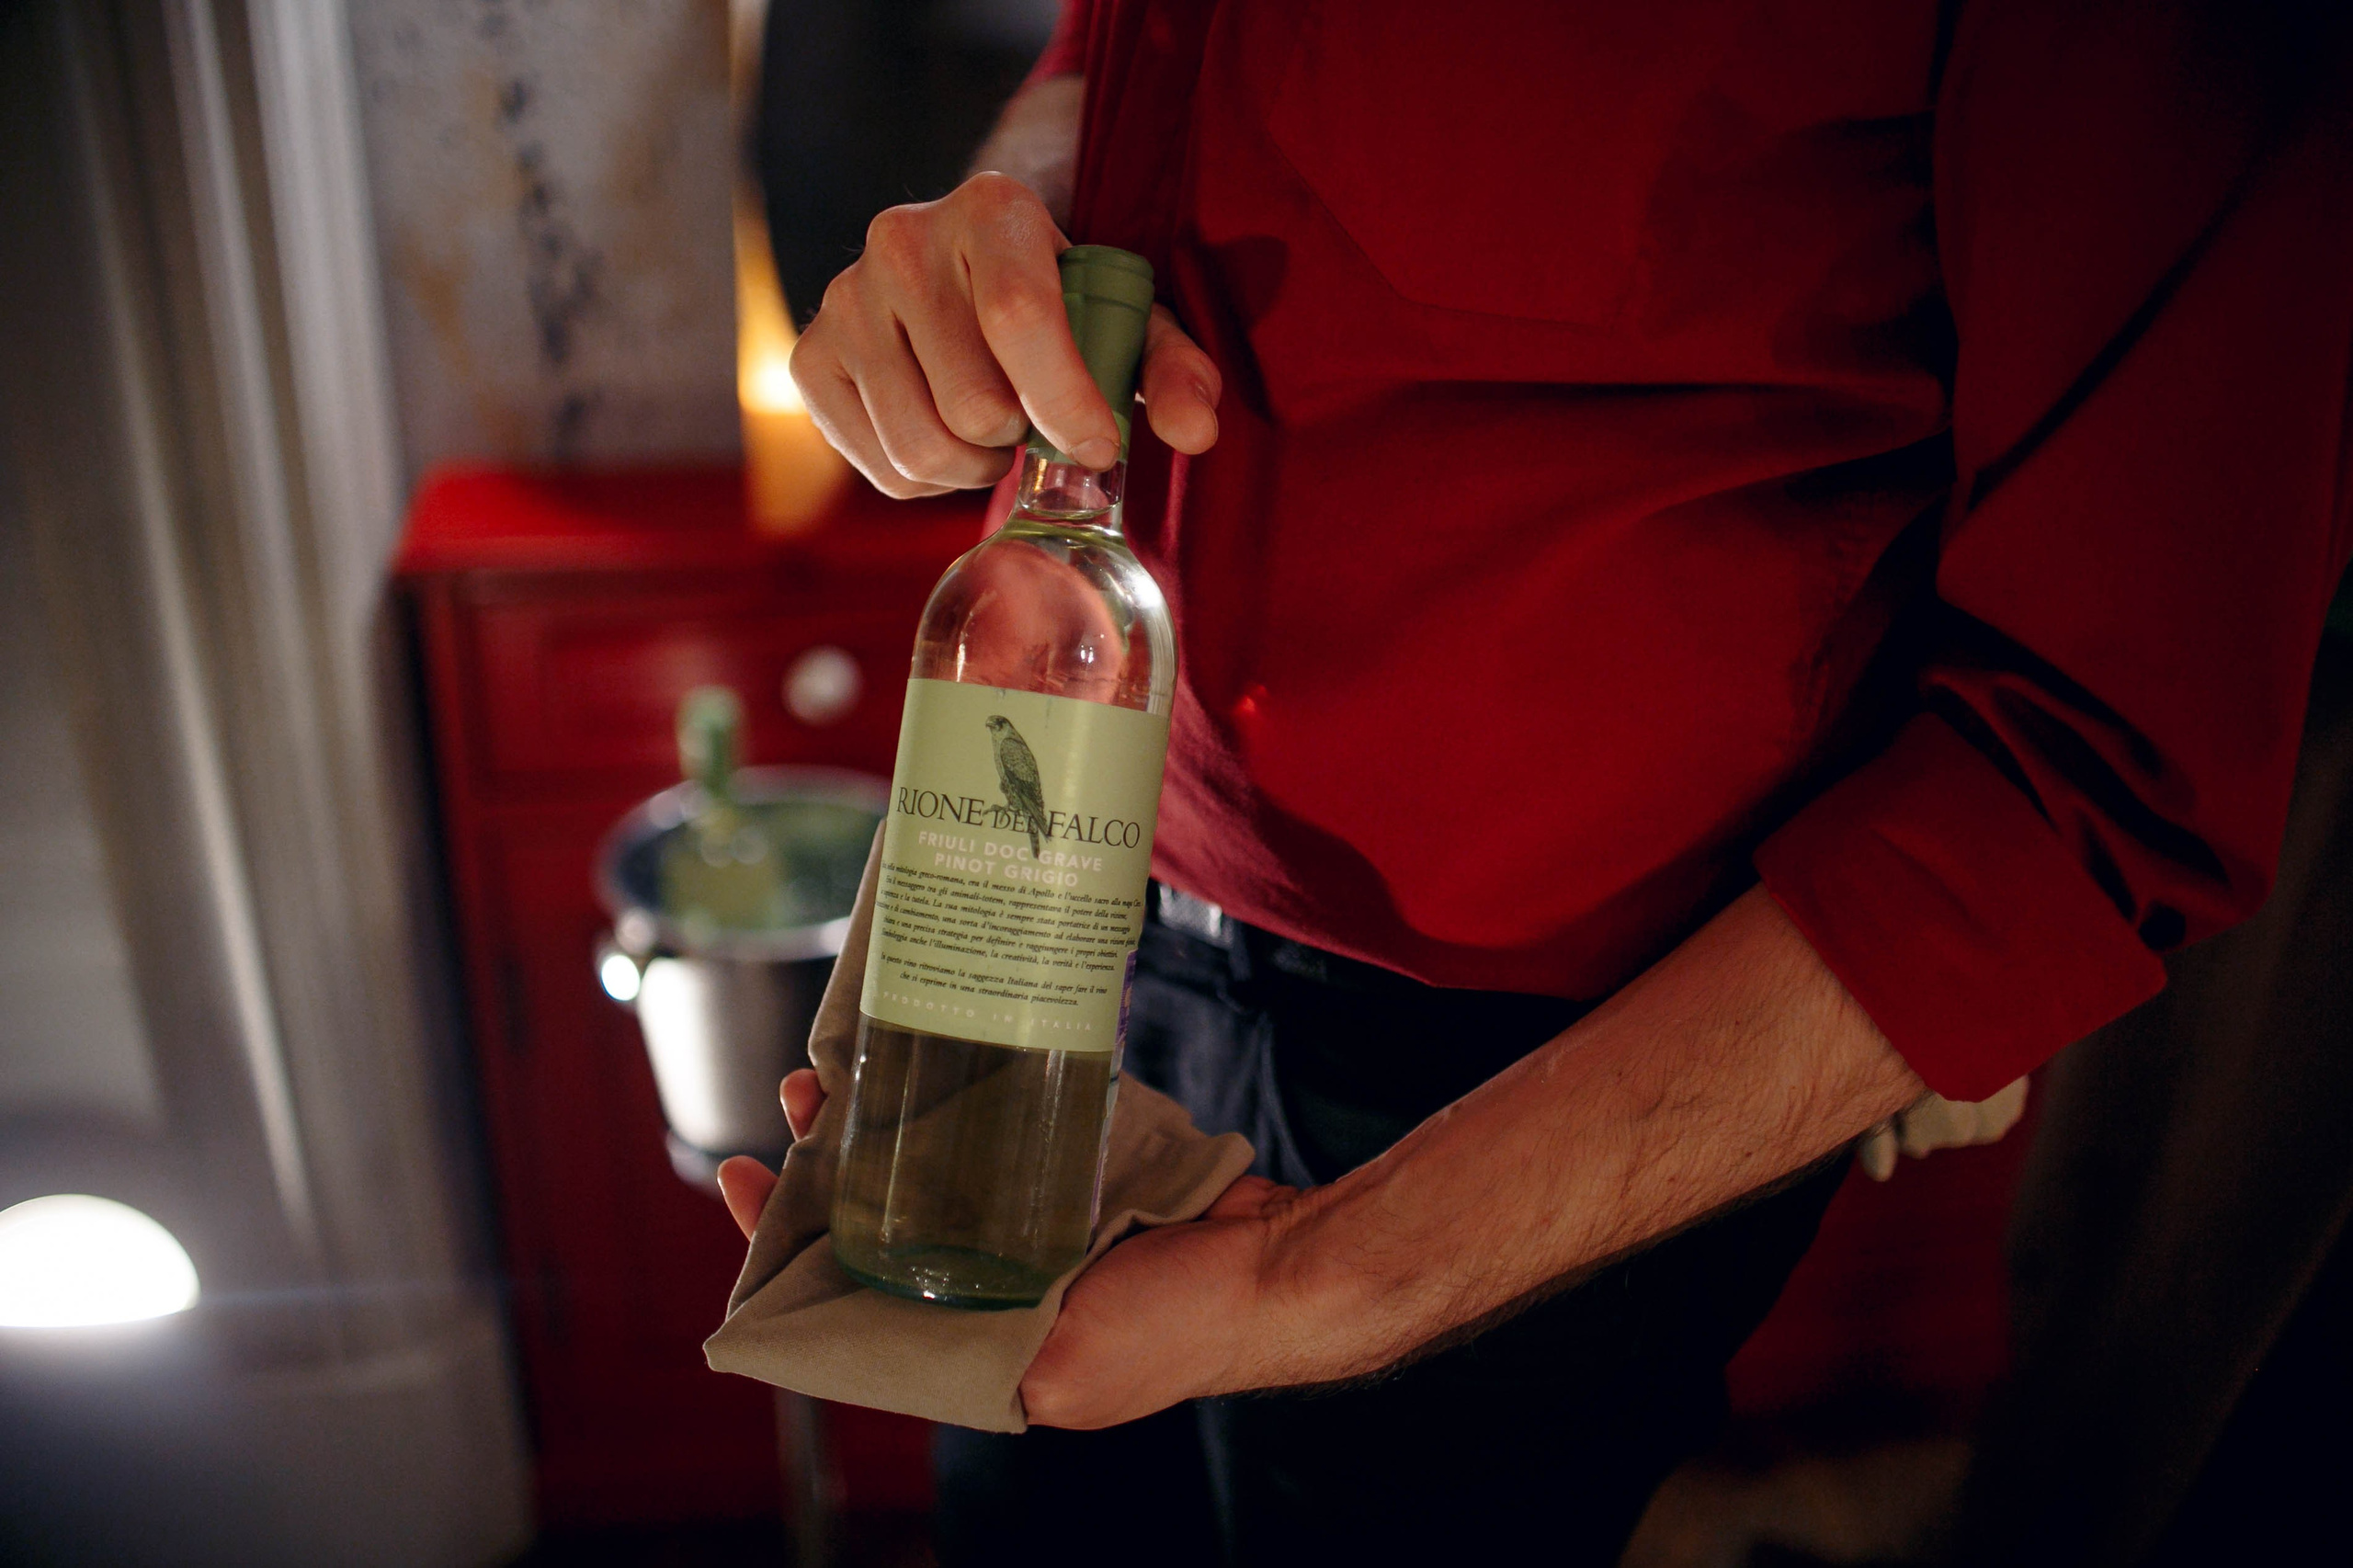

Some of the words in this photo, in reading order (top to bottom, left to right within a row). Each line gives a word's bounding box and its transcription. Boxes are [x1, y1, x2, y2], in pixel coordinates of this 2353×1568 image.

[897, 787, 984, 826] RIONE
[1046, 810, 1141, 848] FALCO
[918, 831, 974, 853] FRIULI
[983, 841, 1029, 861] DOC
[1038, 849, 1103, 871] GRAVE
[935, 852, 996, 875] PINOT
[1004, 865, 1078, 888] GRIGIO
[918, 871, 965, 886] greco-romana,
[983, 880, 989, 889] il
[991, 883, 1016, 893] messo
[1017, 884, 1027, 895] di
[1028, 888, 1054, 900] Apollo
[1064, 892, 1092, 903] l'uccello
[1094, 898, 1109, 906] sacro
[926, 885, 937, 893] tra
[938, 887, 948, 896] gli
[949, 890, 1006, 906] animali-totem,
[1008, 899, 1062, 913] rappresentava
[1064, 904, 1070, 913] il
[1071, 907, 1092, 917] potere
[1094, 906, 1108, 918] della
[904, 892, 910, 902] la
[933, 899, 942, 908] La
[961, 905, 995, 917] mitologia
[1006, 913, 1034, 924] sempre
[1037, 917, 1055, 926] stata
[1057, 920, 1090, 931] portatrice
[1092, 921, 1099, 930] di
[901, 921, 912, 929] una
[913, 924, 936, 936] precisa
[938, 928, 969, 941] strategia
[970, 935, 984, 943] per
[985, 935, 1016, 949] definire
[1026, 943, 1069, 955] raggiungere
[1074, 948, 1096, 958] propri
[942, 915, 957, 925] una
[959, 919, 979, 928] sorta
[980, 920, 1051, 939] d'incoraggiamento
[1053, 931, 1063, 940] ad
[1065, 933, 1096, 944] elaborare
[909, 936, 927, 946] anche
[929, 938, 987, 957] l'illuminazione,
[990, 949, 998, 959] la
[1001, 953, 1039, 964] creatività,
[1041, 957, 1050, 965] la
[1052, 959, 1072, 968] verità
[900, 971, 910, 981] che
[912, 974, 917, 983] si
[919, 976, 947, 989] esprime
[949, 981, 957, 989] in
[960, 985, 975, 994] una
[978, 987, 1029, 1001] straordinaria
[1029, 994, 1079, 1006] piacevolezza.
[904, 959, 917, 968] vino
[919, 961, 955, 975] ritroviamo
[958, 968, 965, 977] la
[968, 972, 1004, 983] saggezza
[1006, 976, 1039, 988] Italiana
[1040, 980, 1051, 990] del
[1054, 984, 1073, 994] saper
[1073, 984, 1087, 994] fare
[1089, 985, 1095, 994] il
[883, 991, 975, 1018] PRODOTTO
[993, 1013, 1012, 1024] IN
[1030, 1018, 1091, 1031] ITALIA
